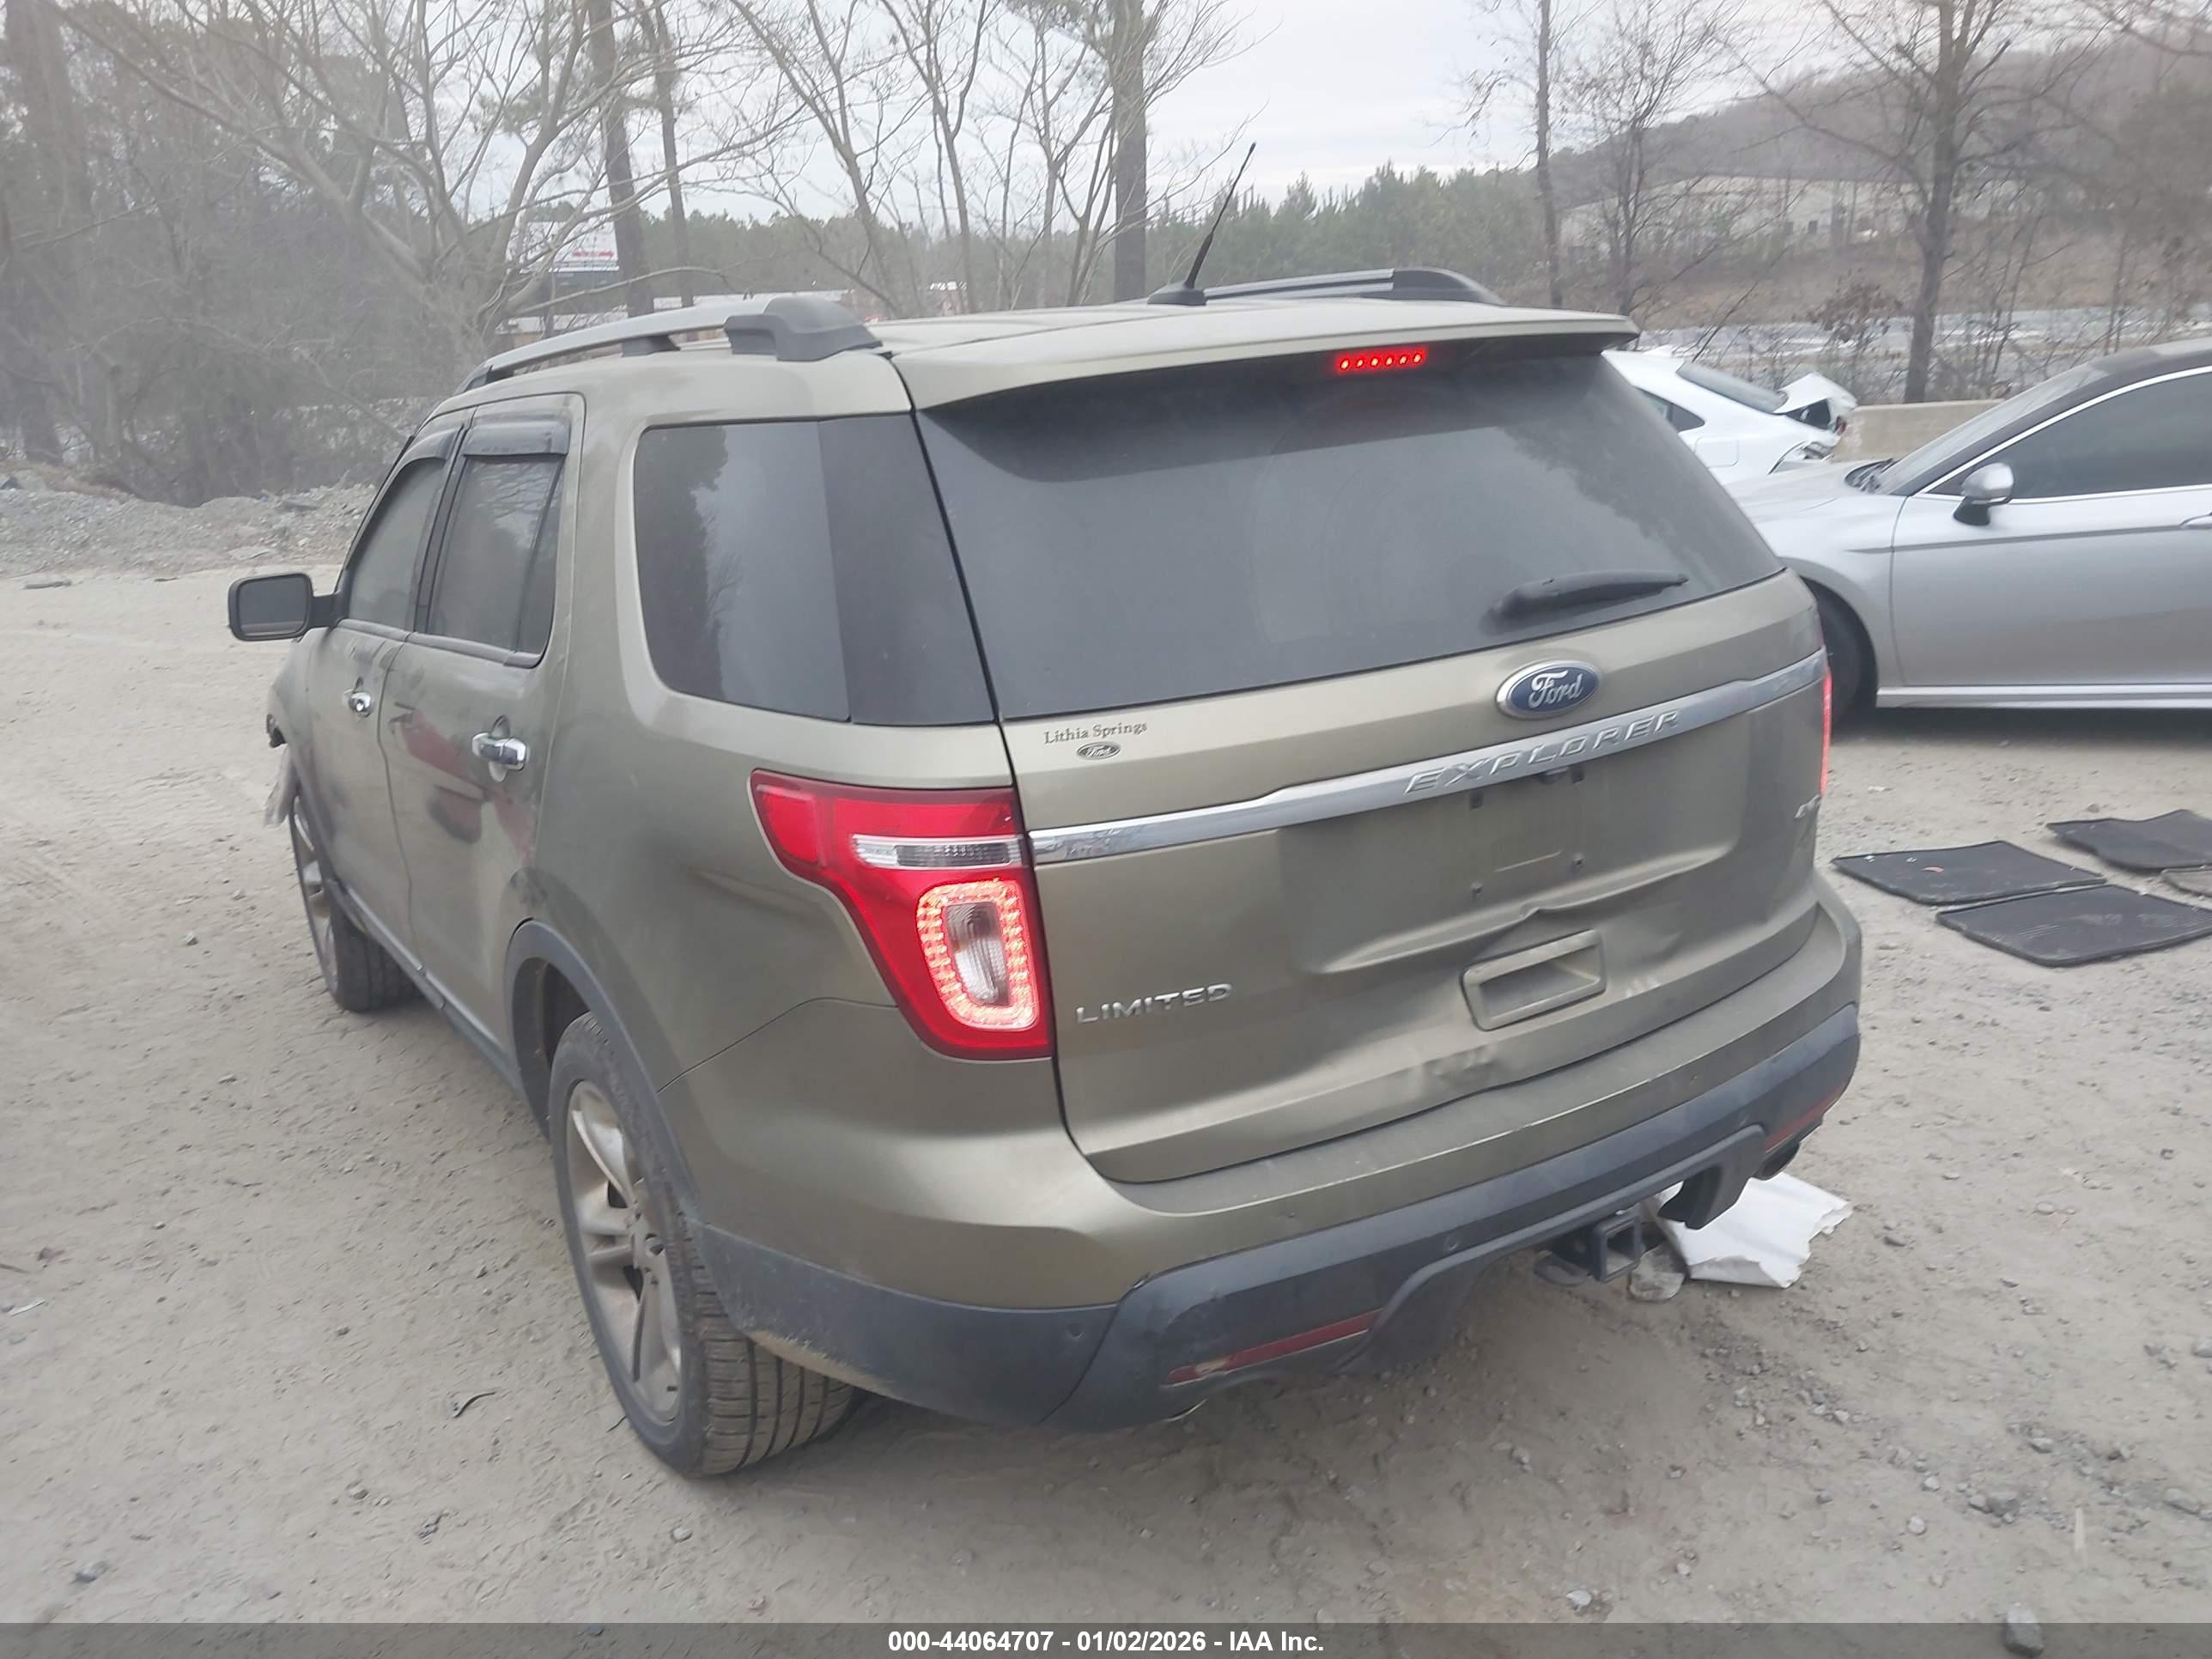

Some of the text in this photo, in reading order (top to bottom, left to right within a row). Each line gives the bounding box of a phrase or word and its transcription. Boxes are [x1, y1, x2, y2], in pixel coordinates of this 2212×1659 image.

[1527, 669, 1584, 708] Ford
[1043, 721, 1148, 745] Lithia Springs
[1404, 709, 1680, 795] EXPLORER
[1075, 982, 1233, 1024] LIMITED
